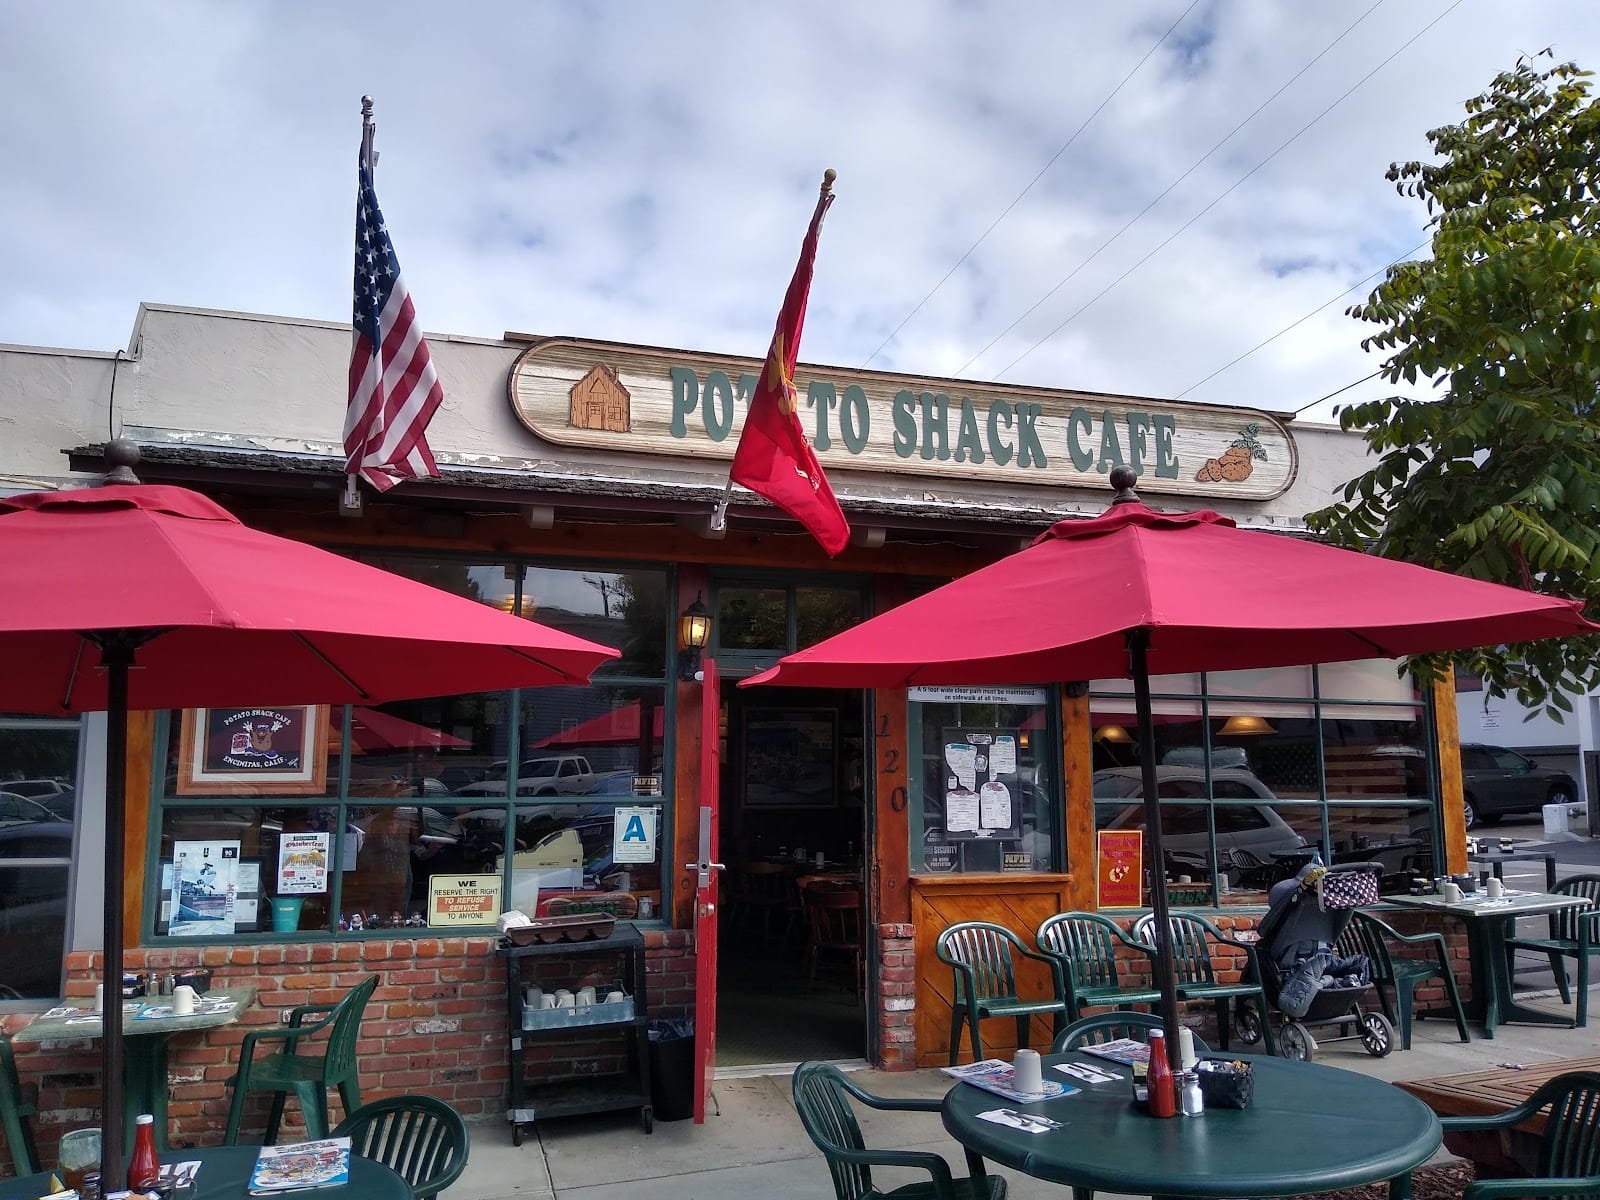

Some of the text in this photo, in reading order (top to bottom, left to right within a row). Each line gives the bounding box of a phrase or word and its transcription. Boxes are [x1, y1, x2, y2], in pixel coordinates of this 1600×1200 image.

[669, 366, 1179, 480] POTO SHACK CAFE
[223, 709, 292, 726] POTATO SHACK CAFE
[222, 755, 263, 769] ENCINITAS,
[264, 757, 288, 768] CALIF.
[622, 815, 647, 842] A
[933, 845, 958, 855] SECURITY
[458, 880, 477, 888] WE
[434, 888, 499, 896] RESERVE THE RIGHT
[456, 896, 486, 904] REFUSE
[448, 904, 480, 912] SERVICE
[448, 912, 484, 920] TO ANYONE
